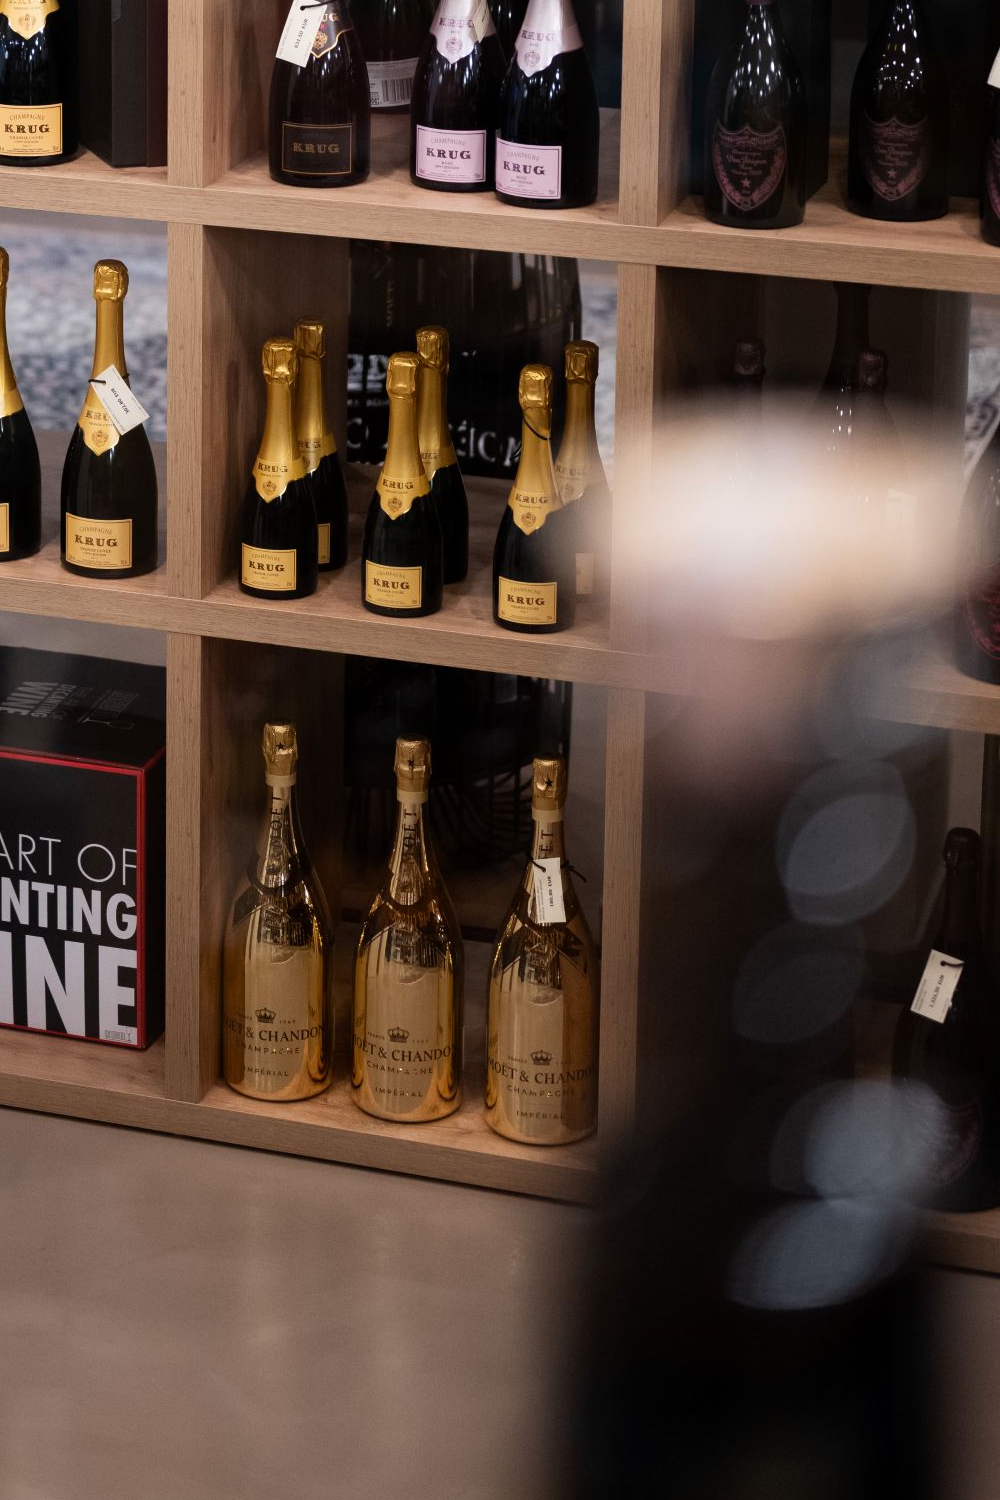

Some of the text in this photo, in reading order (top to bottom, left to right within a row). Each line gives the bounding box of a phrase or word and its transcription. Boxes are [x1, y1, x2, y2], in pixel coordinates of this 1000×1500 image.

[320, 12, 339, 22] UG
[439, 17, 474, 28] KRUG
[521, 30, 555, 42] KRUG
[4, 124, 50, 134] KRUG
[293, 142, 340, 154] KRUG
[431, 137, 466, 147] CHAMPAGNE
[426, 147, 472, 160] KRUG
[507, 152, 540, 162] CHAMPAGNE
[503, 160, 546, 176] KRUG
[111, 388, 119, 398] EUR
[85, 410, 110, 421] KRU
[257, 462, 289, 473] KRUG
[382, 479, 414, 490] KRUG
[515, 494, 548, 504] KRUG
[75, 534, 118, 547] KRUG
[248, 560, 285, 572] KRUG
[373, 578, 411, 590] KRUG
[506, 594, 546, 606] KRUG
[540, 829, 553, 852] ËT
[77, 843, 138, 886] OF
[246, 1027, 255, 1039] &
[258, 1024, 325, 1043] CHANDON
[235, 1041, 301, 1055] CHAMPAGNE
[378, 1048, 387, 1059] &
[243, 1066, 290, 1077] IMPÉRIAL
[366, 1061, 434, 1075] CHAMPAGNE
[520, 1070, 529, 1083] &
[375, 1086, 424, 1098] IMPÉRIAL
